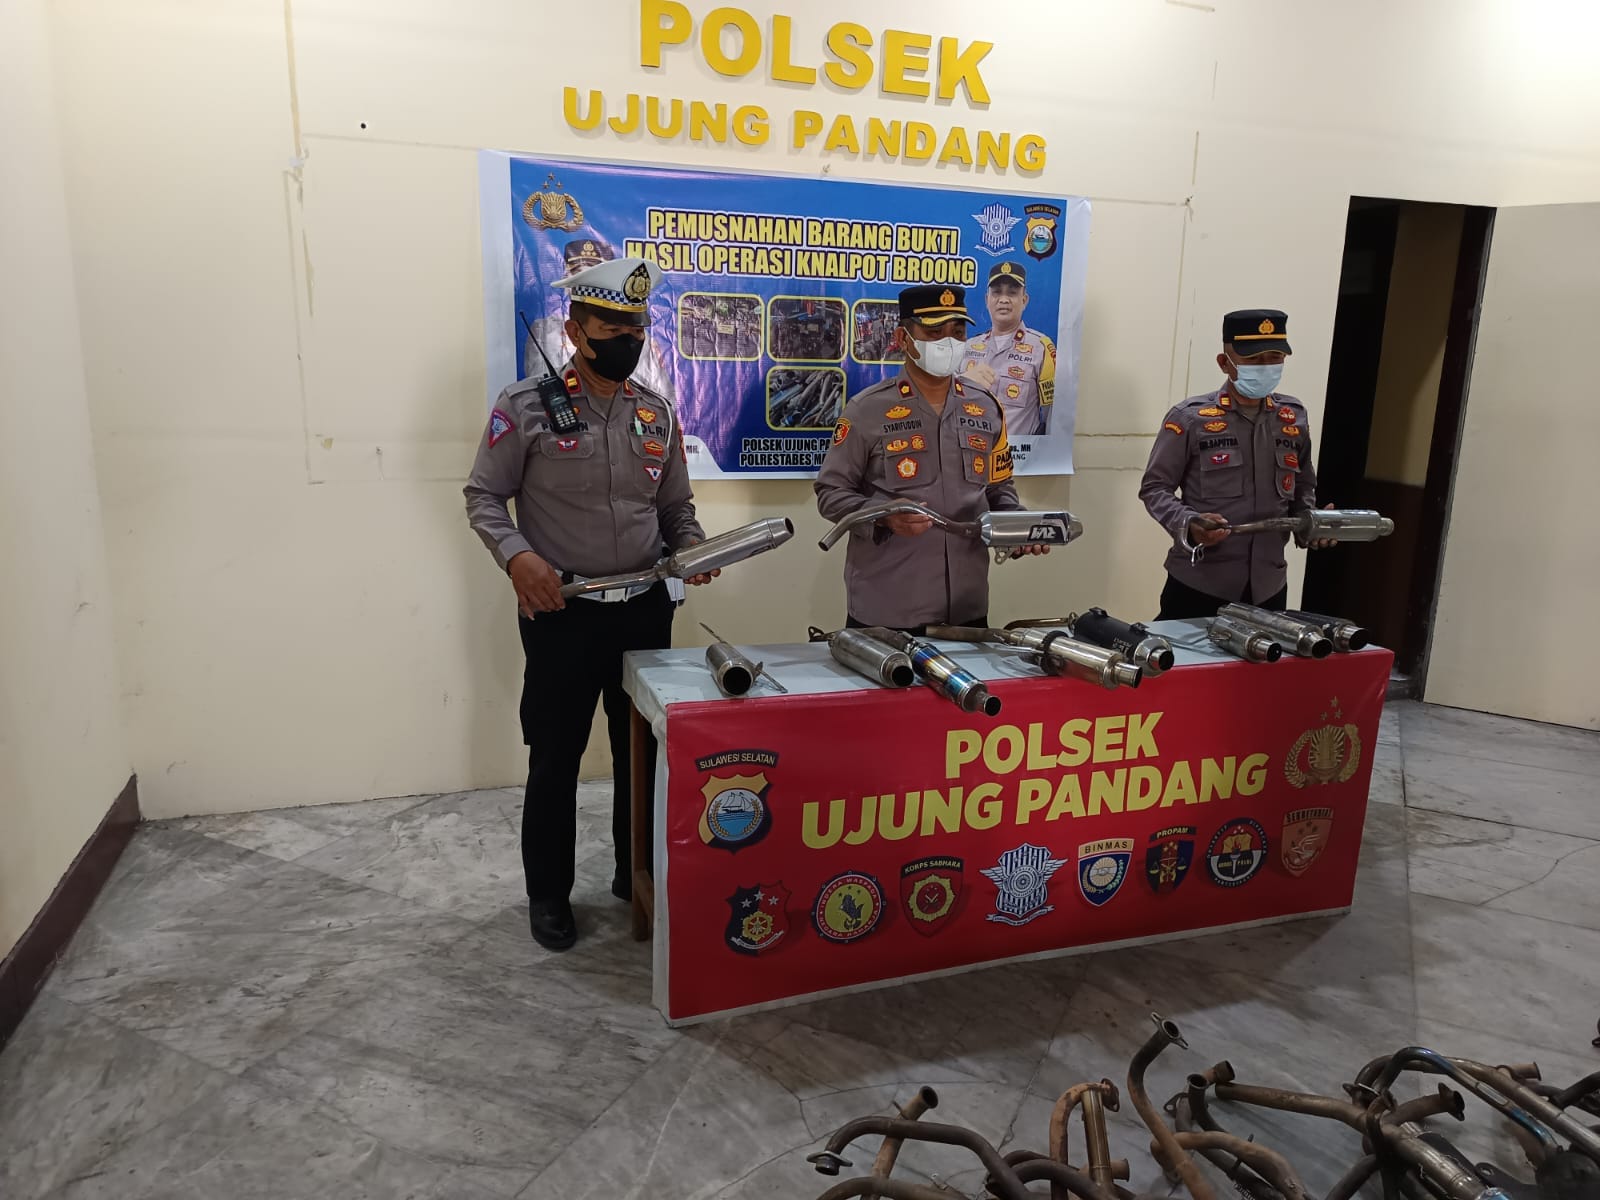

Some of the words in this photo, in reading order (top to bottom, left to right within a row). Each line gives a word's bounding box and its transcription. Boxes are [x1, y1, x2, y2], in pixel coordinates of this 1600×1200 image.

[640, 0, 993, 104] POLSEK
[563, 86, 770, 146] UJUNG
[793, 109, 1047, 172] PANDANG
[649, 209, 803, 246] PEMUSNAHAN
[806, 218, 894, 252] BARANG
[896, 225, 959, 256] BUKTI
[625, 240, 694, 272] HASIL
[697, 244, 793, 276] OPERASI
[795, 250, 890, 281] KNALPOT
[892, 255, 977, 286] BROONG
[1008, 353, 1033, 363] POLRI
[959, 417, 993, 431] POLRI
[743, 437, 784, 452] POLSEK
[784, 437, 818, 452] UJUNG
[740, 452, 812, 466] POLRESTABES
[945, 711, 1164, 779] POLSEK
[700, 753, 740, 769] SULAWESI
[741, 752, 776, 766] SELATAN
[801, 782, 1004, 850] UJUNG
[1015, 753, 1270, 825] PANDANG
[1156, 827, 1189, 839] PROPAM
[1085, 841, 1128, 854] BINMAS
[904, 861, 929, 874] KORPS
[929, 860, 961, 868] SABHARA
[846, 878, 877, 899] WASPADA
